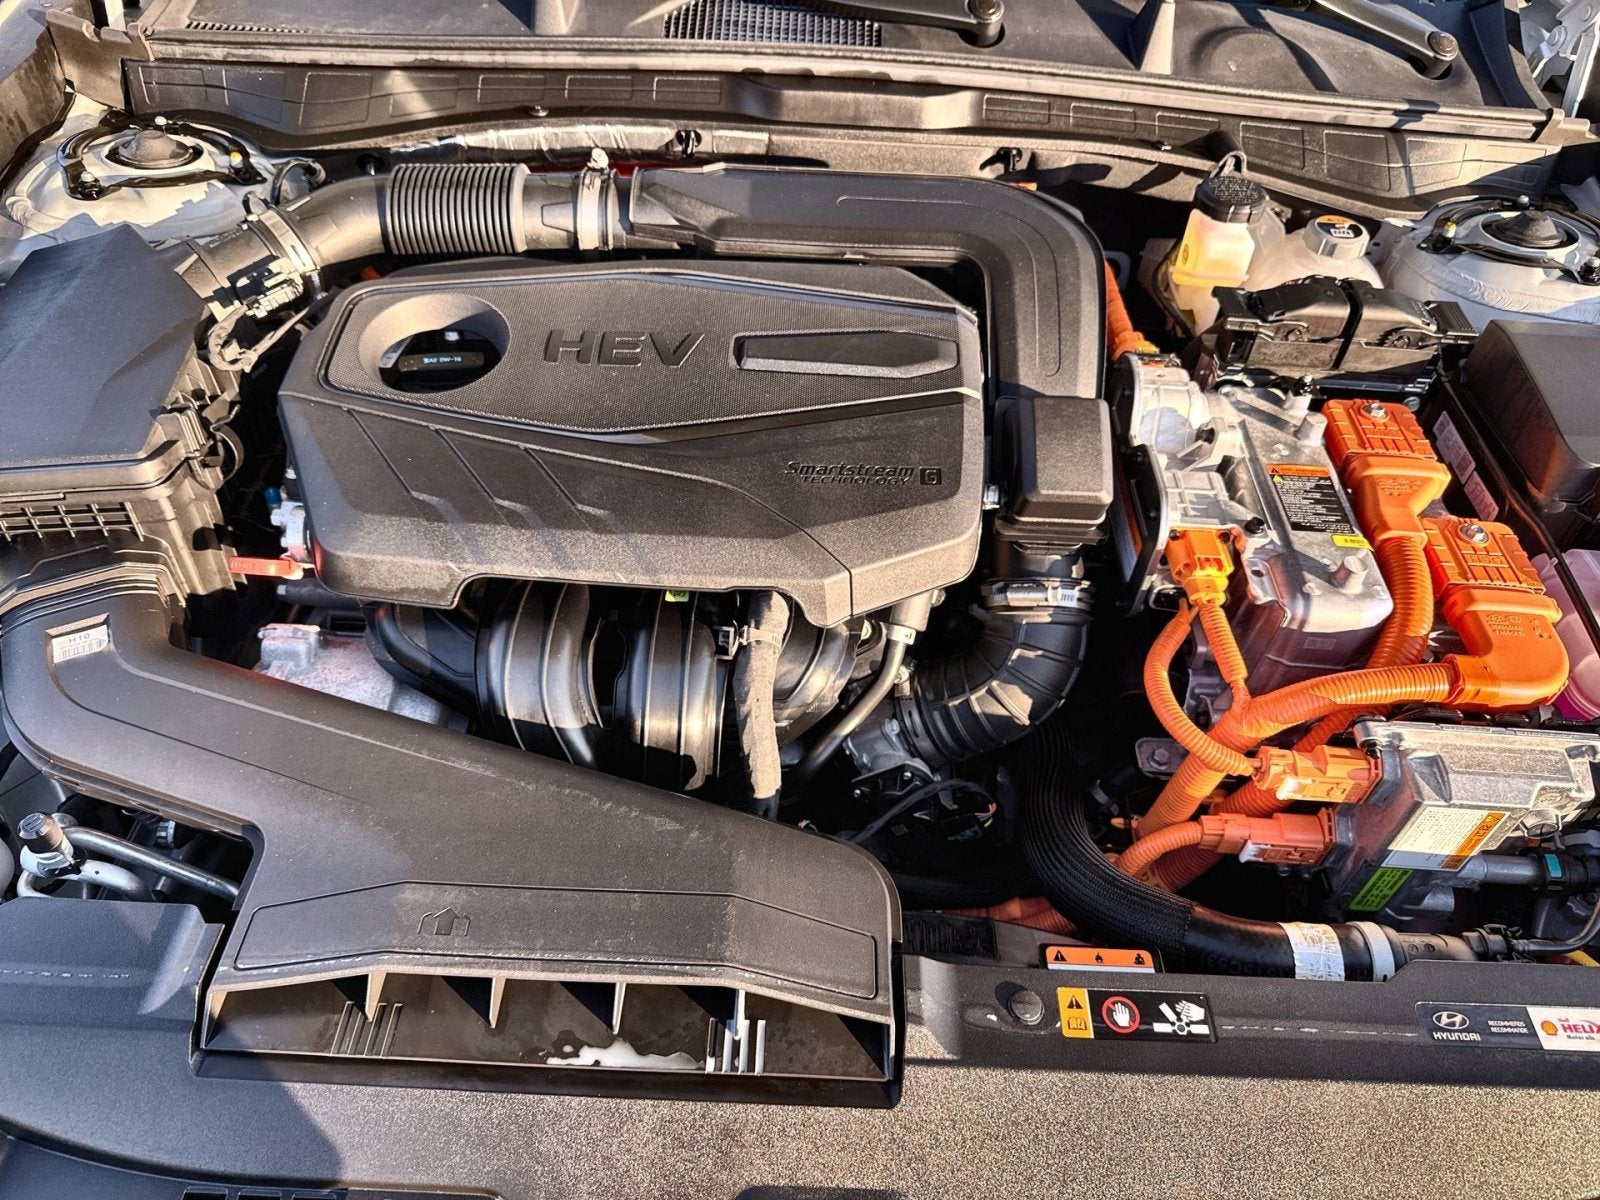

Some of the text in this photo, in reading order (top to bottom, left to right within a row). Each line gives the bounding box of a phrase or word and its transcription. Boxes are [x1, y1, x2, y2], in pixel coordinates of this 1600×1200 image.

[543, 329, 705, 368] HEV
[784, 460, 940, 485] Smartstream G
[801, 475, 910, 486] TECHNOLOGY
[1490, 1026, 1529, 1034] RECOMMANDE
[1433, 1031, 1481, 1042] HYUNDAI
